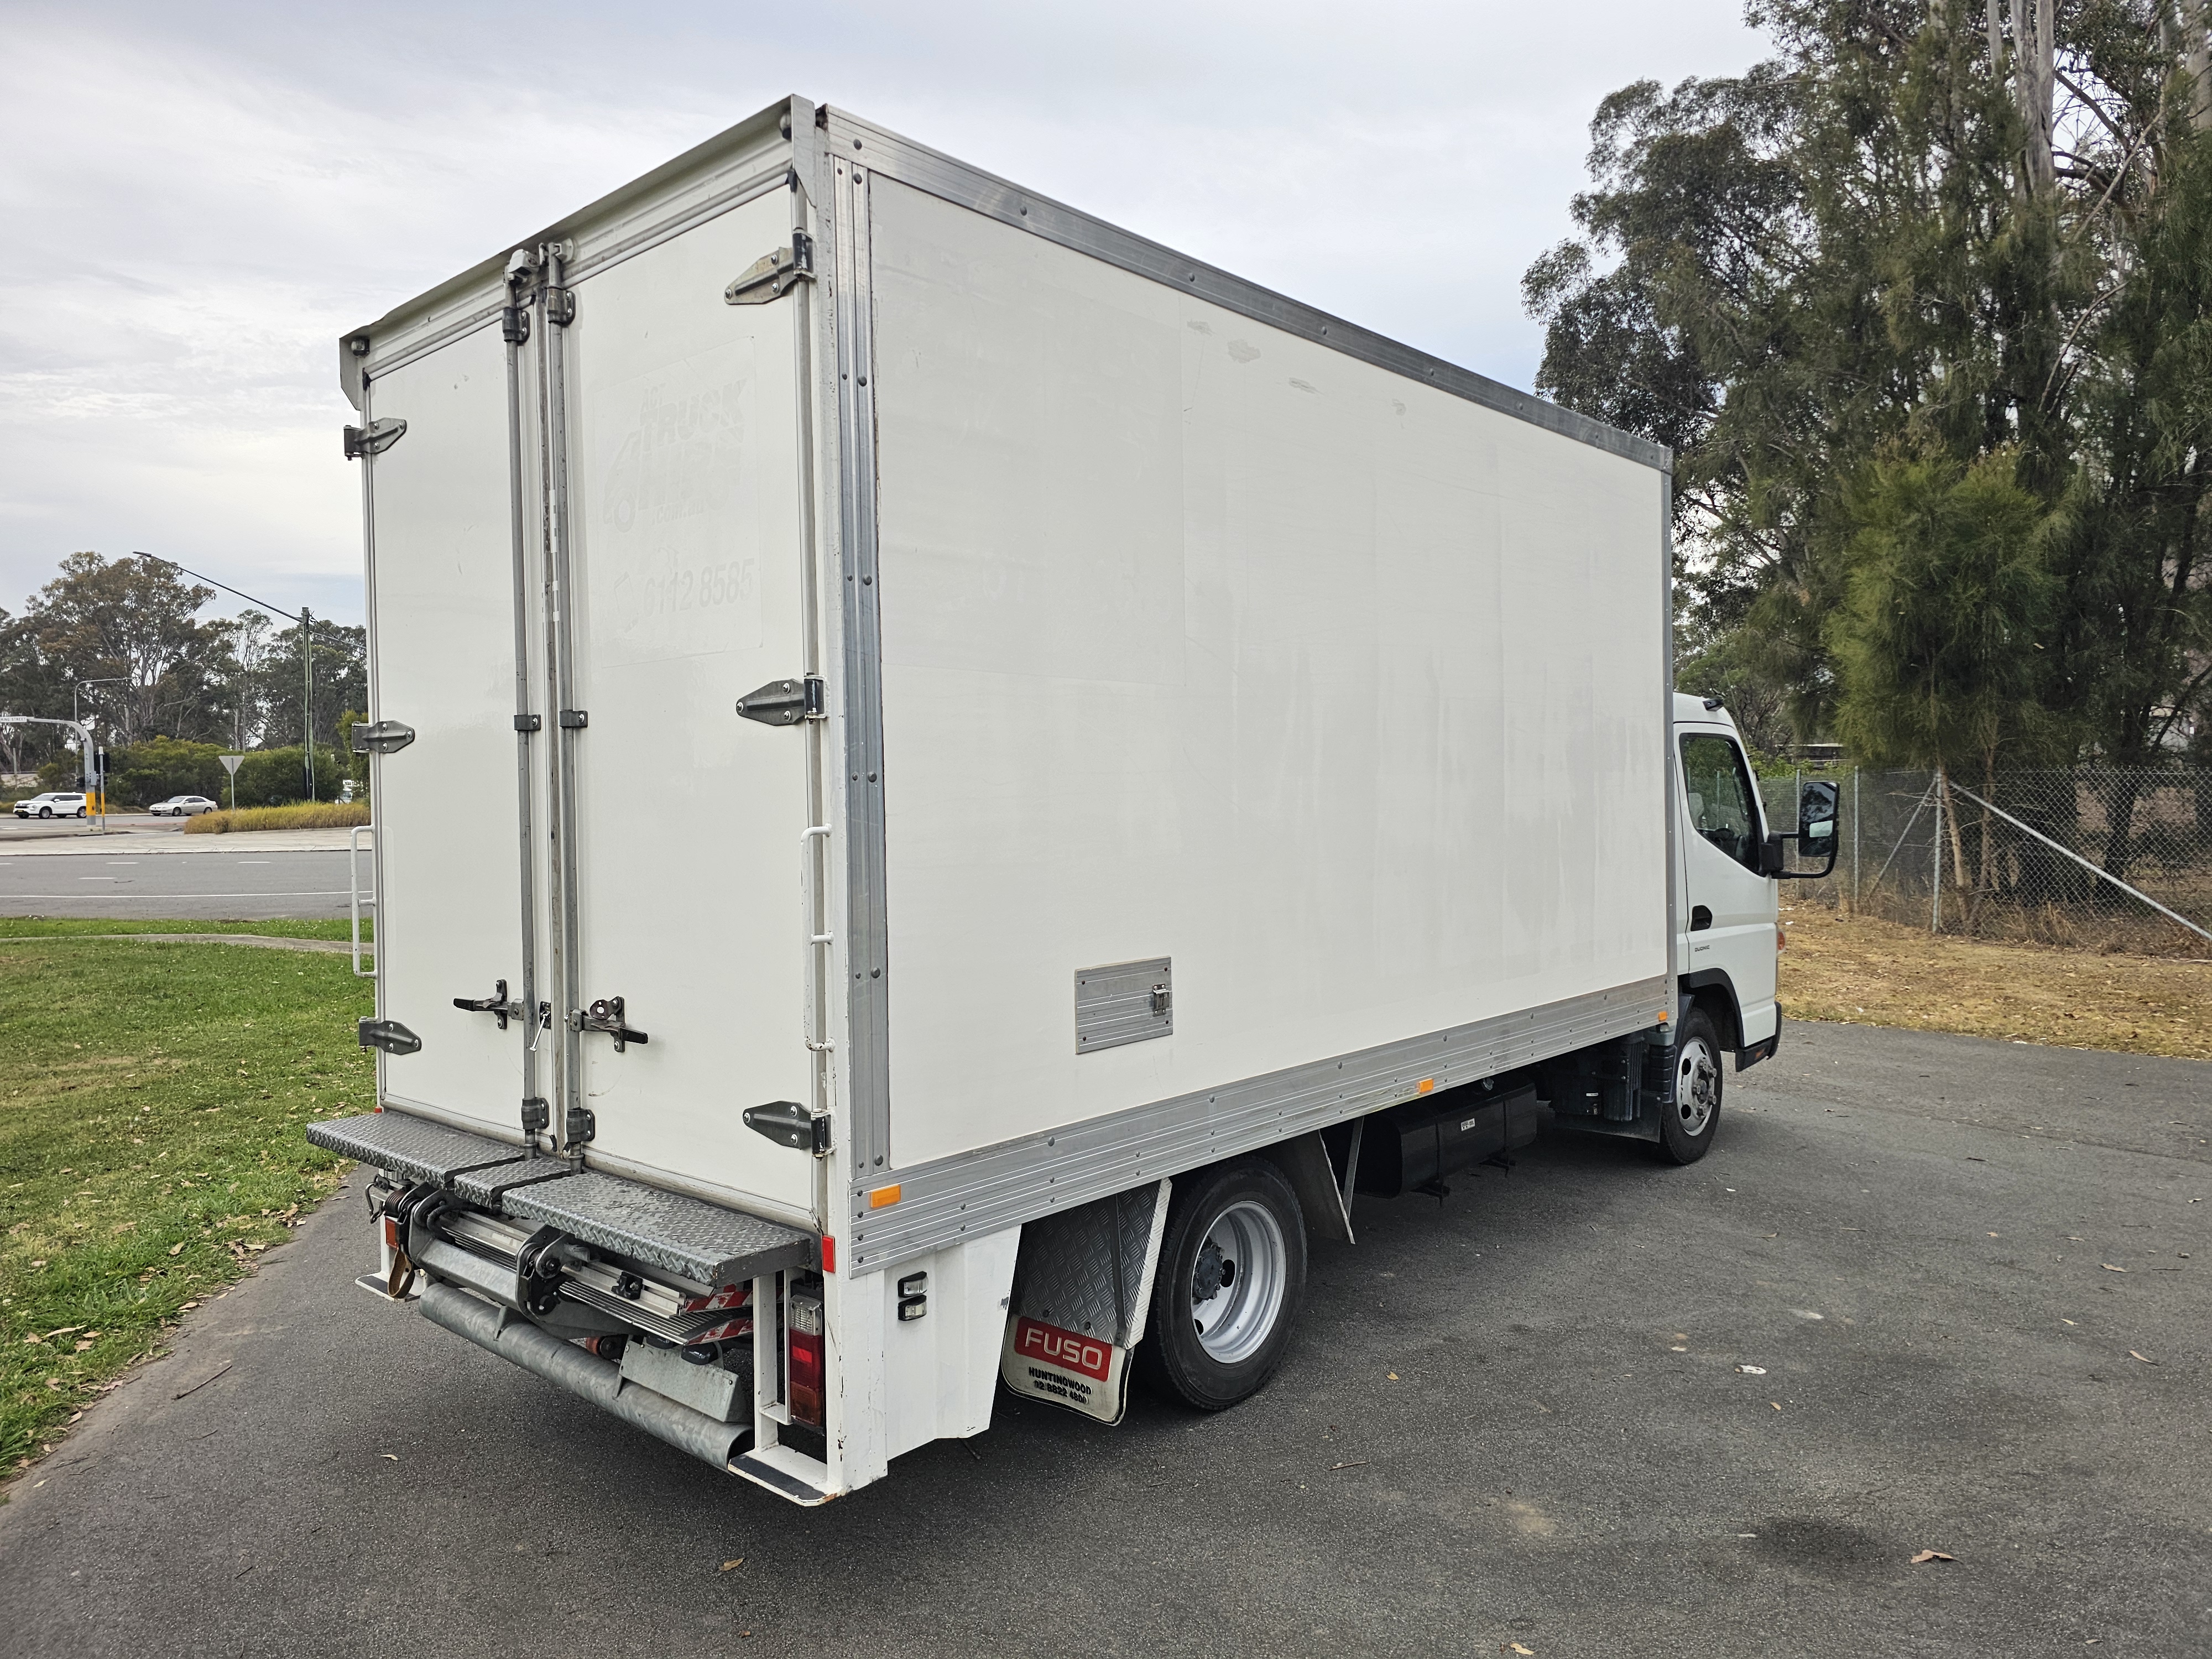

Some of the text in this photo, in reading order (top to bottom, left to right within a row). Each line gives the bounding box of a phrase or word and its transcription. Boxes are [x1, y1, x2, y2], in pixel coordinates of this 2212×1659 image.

[640, 378, 747, 452] TRUCK
[699, 558, 754, 608] 8585
[1025, 1327, 1103, 1370] FUSO
[1029, 1366, 1092, 1395] HUNTINGWOOD
[1034, 1379, 1046, 1391] 02
